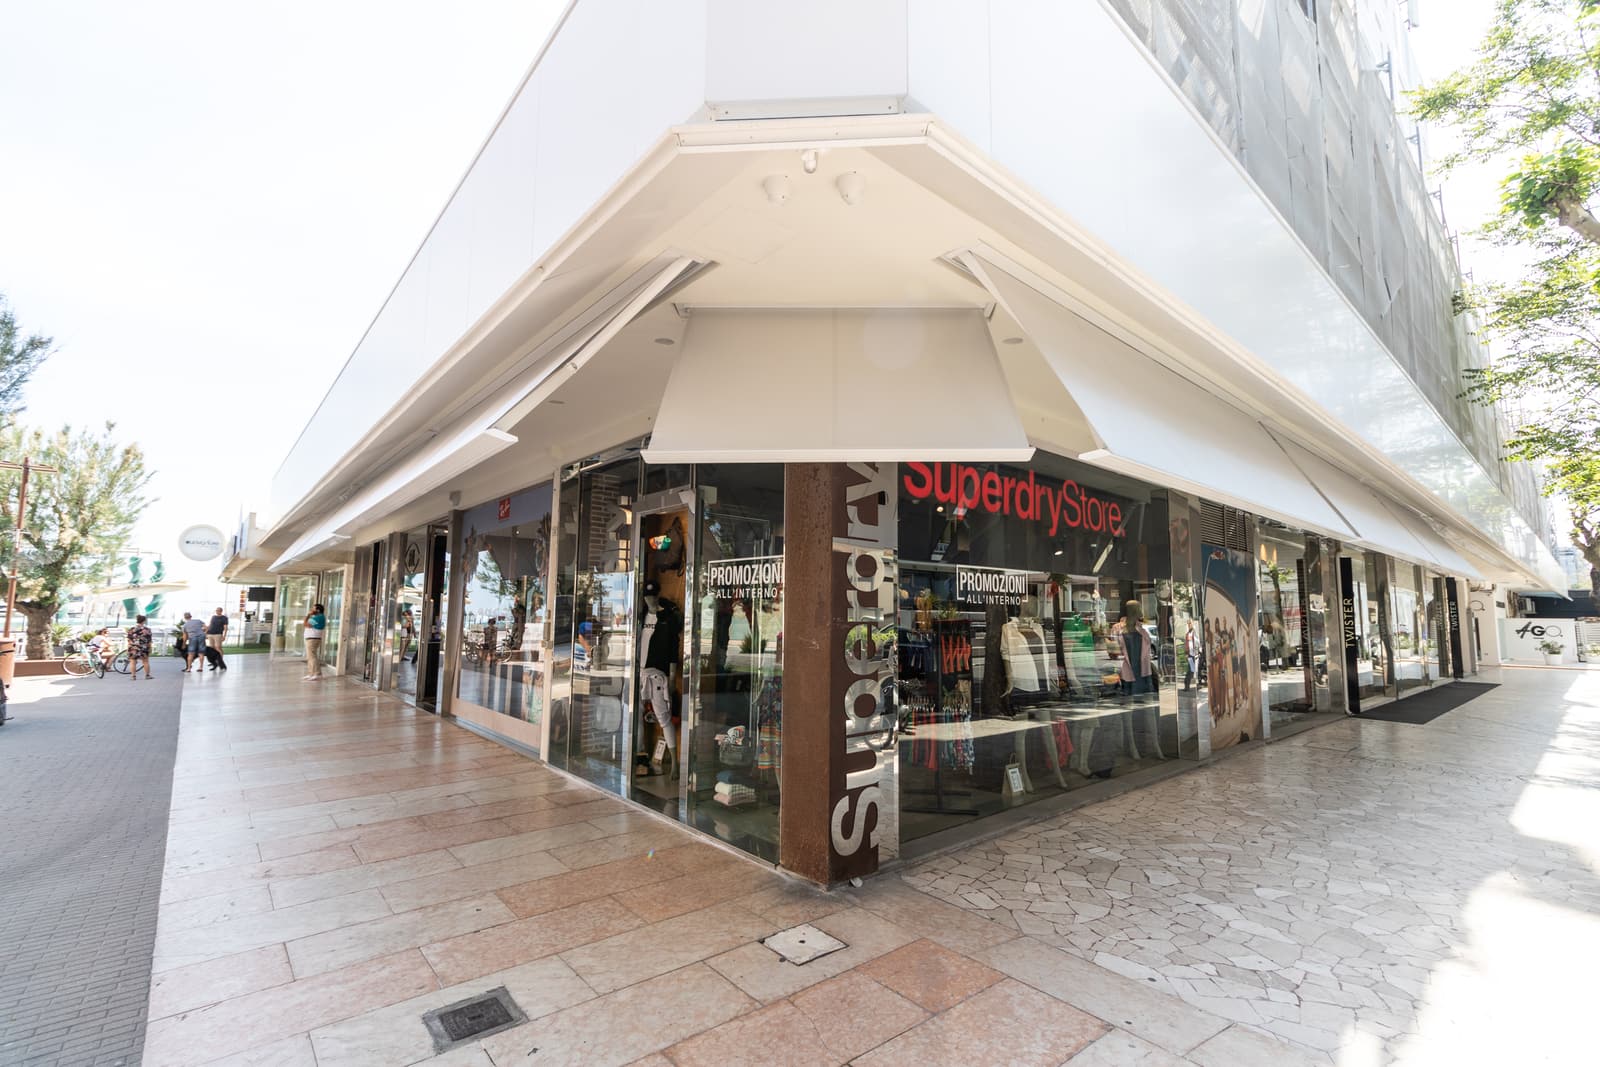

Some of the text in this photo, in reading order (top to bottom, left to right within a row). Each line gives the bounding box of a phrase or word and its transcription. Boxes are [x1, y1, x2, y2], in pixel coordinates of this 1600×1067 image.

[716, 587, 778, 599] ALL'INTERNO
[960, 572, 1026, 594] PROMOZIONI
[966, 593, 1021, 606] ALL'INTERNO
[1343, 598, 1356, 649] TWISTER
[1450, 600, 1458, 631] TWISTER
